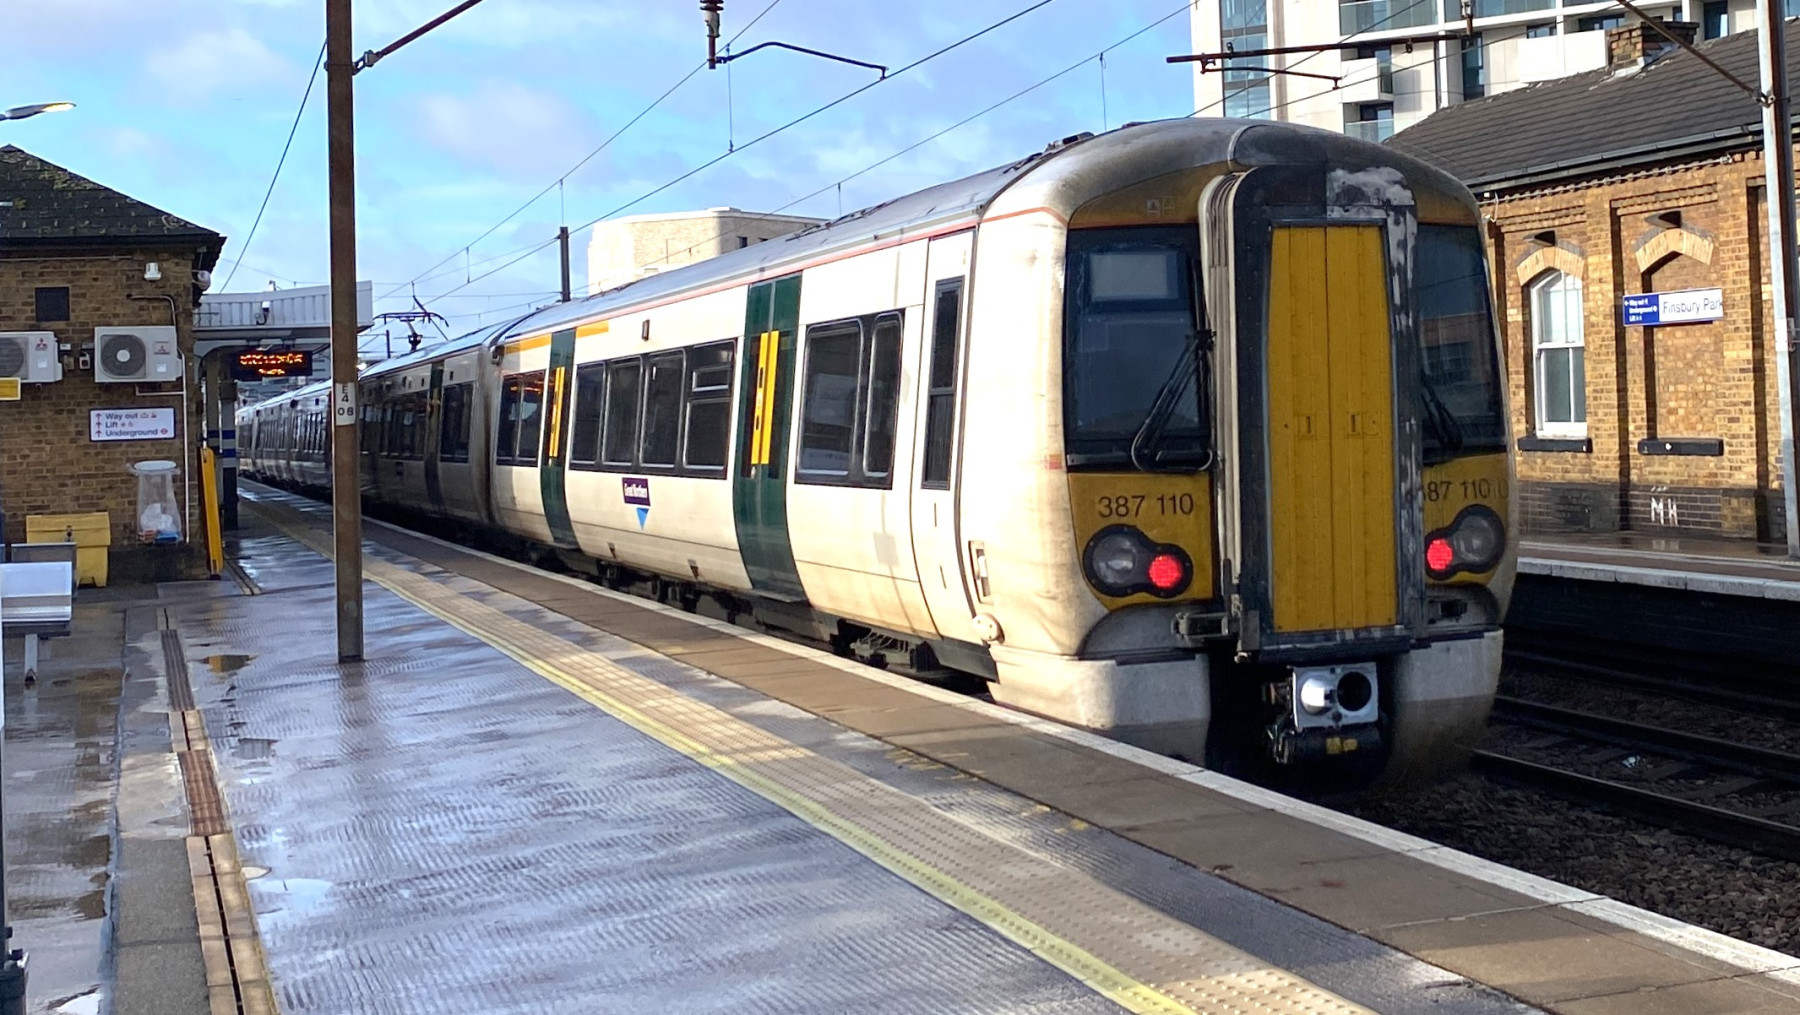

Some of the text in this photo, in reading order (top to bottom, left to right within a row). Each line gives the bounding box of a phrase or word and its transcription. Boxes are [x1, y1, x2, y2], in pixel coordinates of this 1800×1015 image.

[1663, 301, 1700, 314] Finsbury
[105, 412, 123, 421] Way
[105, 421, 118, 429] Lift
[105, 428, 158, 437] Underground
[1098, 493, 1194, 518] 387 110
